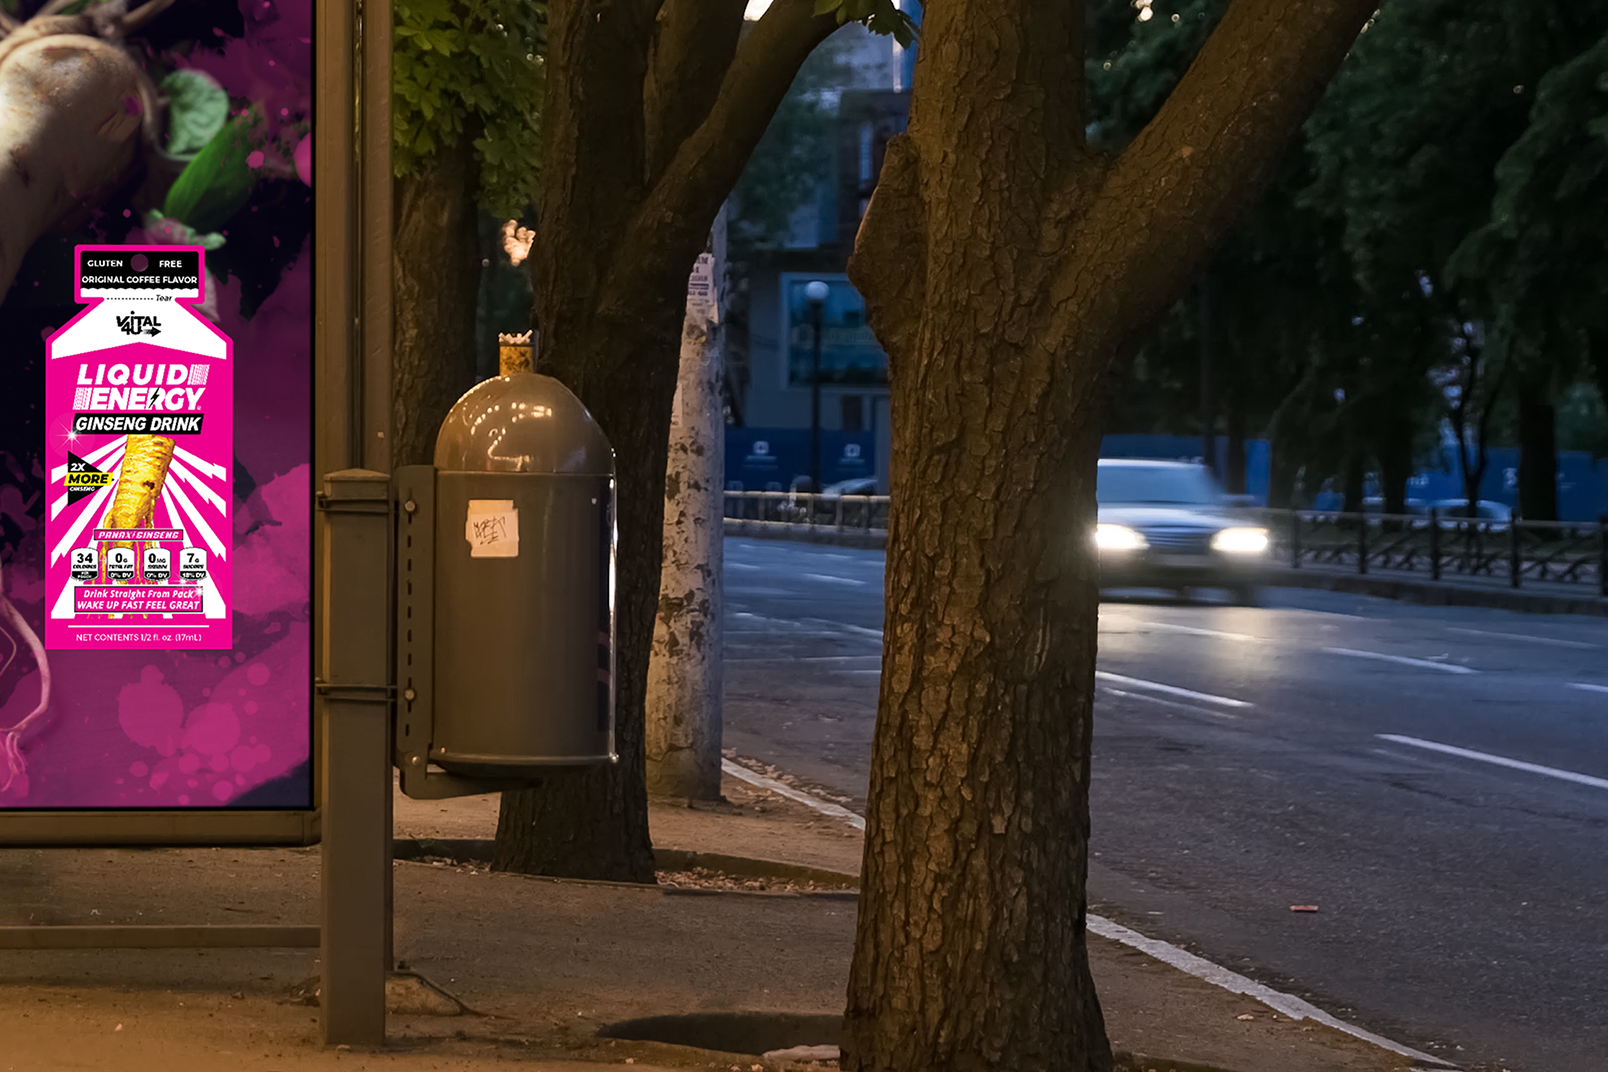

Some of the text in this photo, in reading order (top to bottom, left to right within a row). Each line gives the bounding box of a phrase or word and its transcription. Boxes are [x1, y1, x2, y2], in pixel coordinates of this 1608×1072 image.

[159, 260, 182, 268] FREE
[126, 276, 161, 284] COFFEE
[162, 276, 198, 284] FLAVOR
[156, 294, 173, 302] Tear
[77, 363, 188, 385] LIQUID
[90, 387, 206, 411] ENERGY
[76, 417, 202, 431] GINSENG DRINK
[70, 463, 86, 471] 2X
[68, 474, 109, 484] MORE
[98, 531, 179, 539] PANAX GINSENG
[77, 553, 93, 563] 34
[83, 589, 193, 600] Drink Straight From Pack
[77, 601, 200, 609] WAKE UP FAST FEEL GREAT
[140, 634, 152, 642] 1/2
[175, 634, 202, 642] (17mL)
